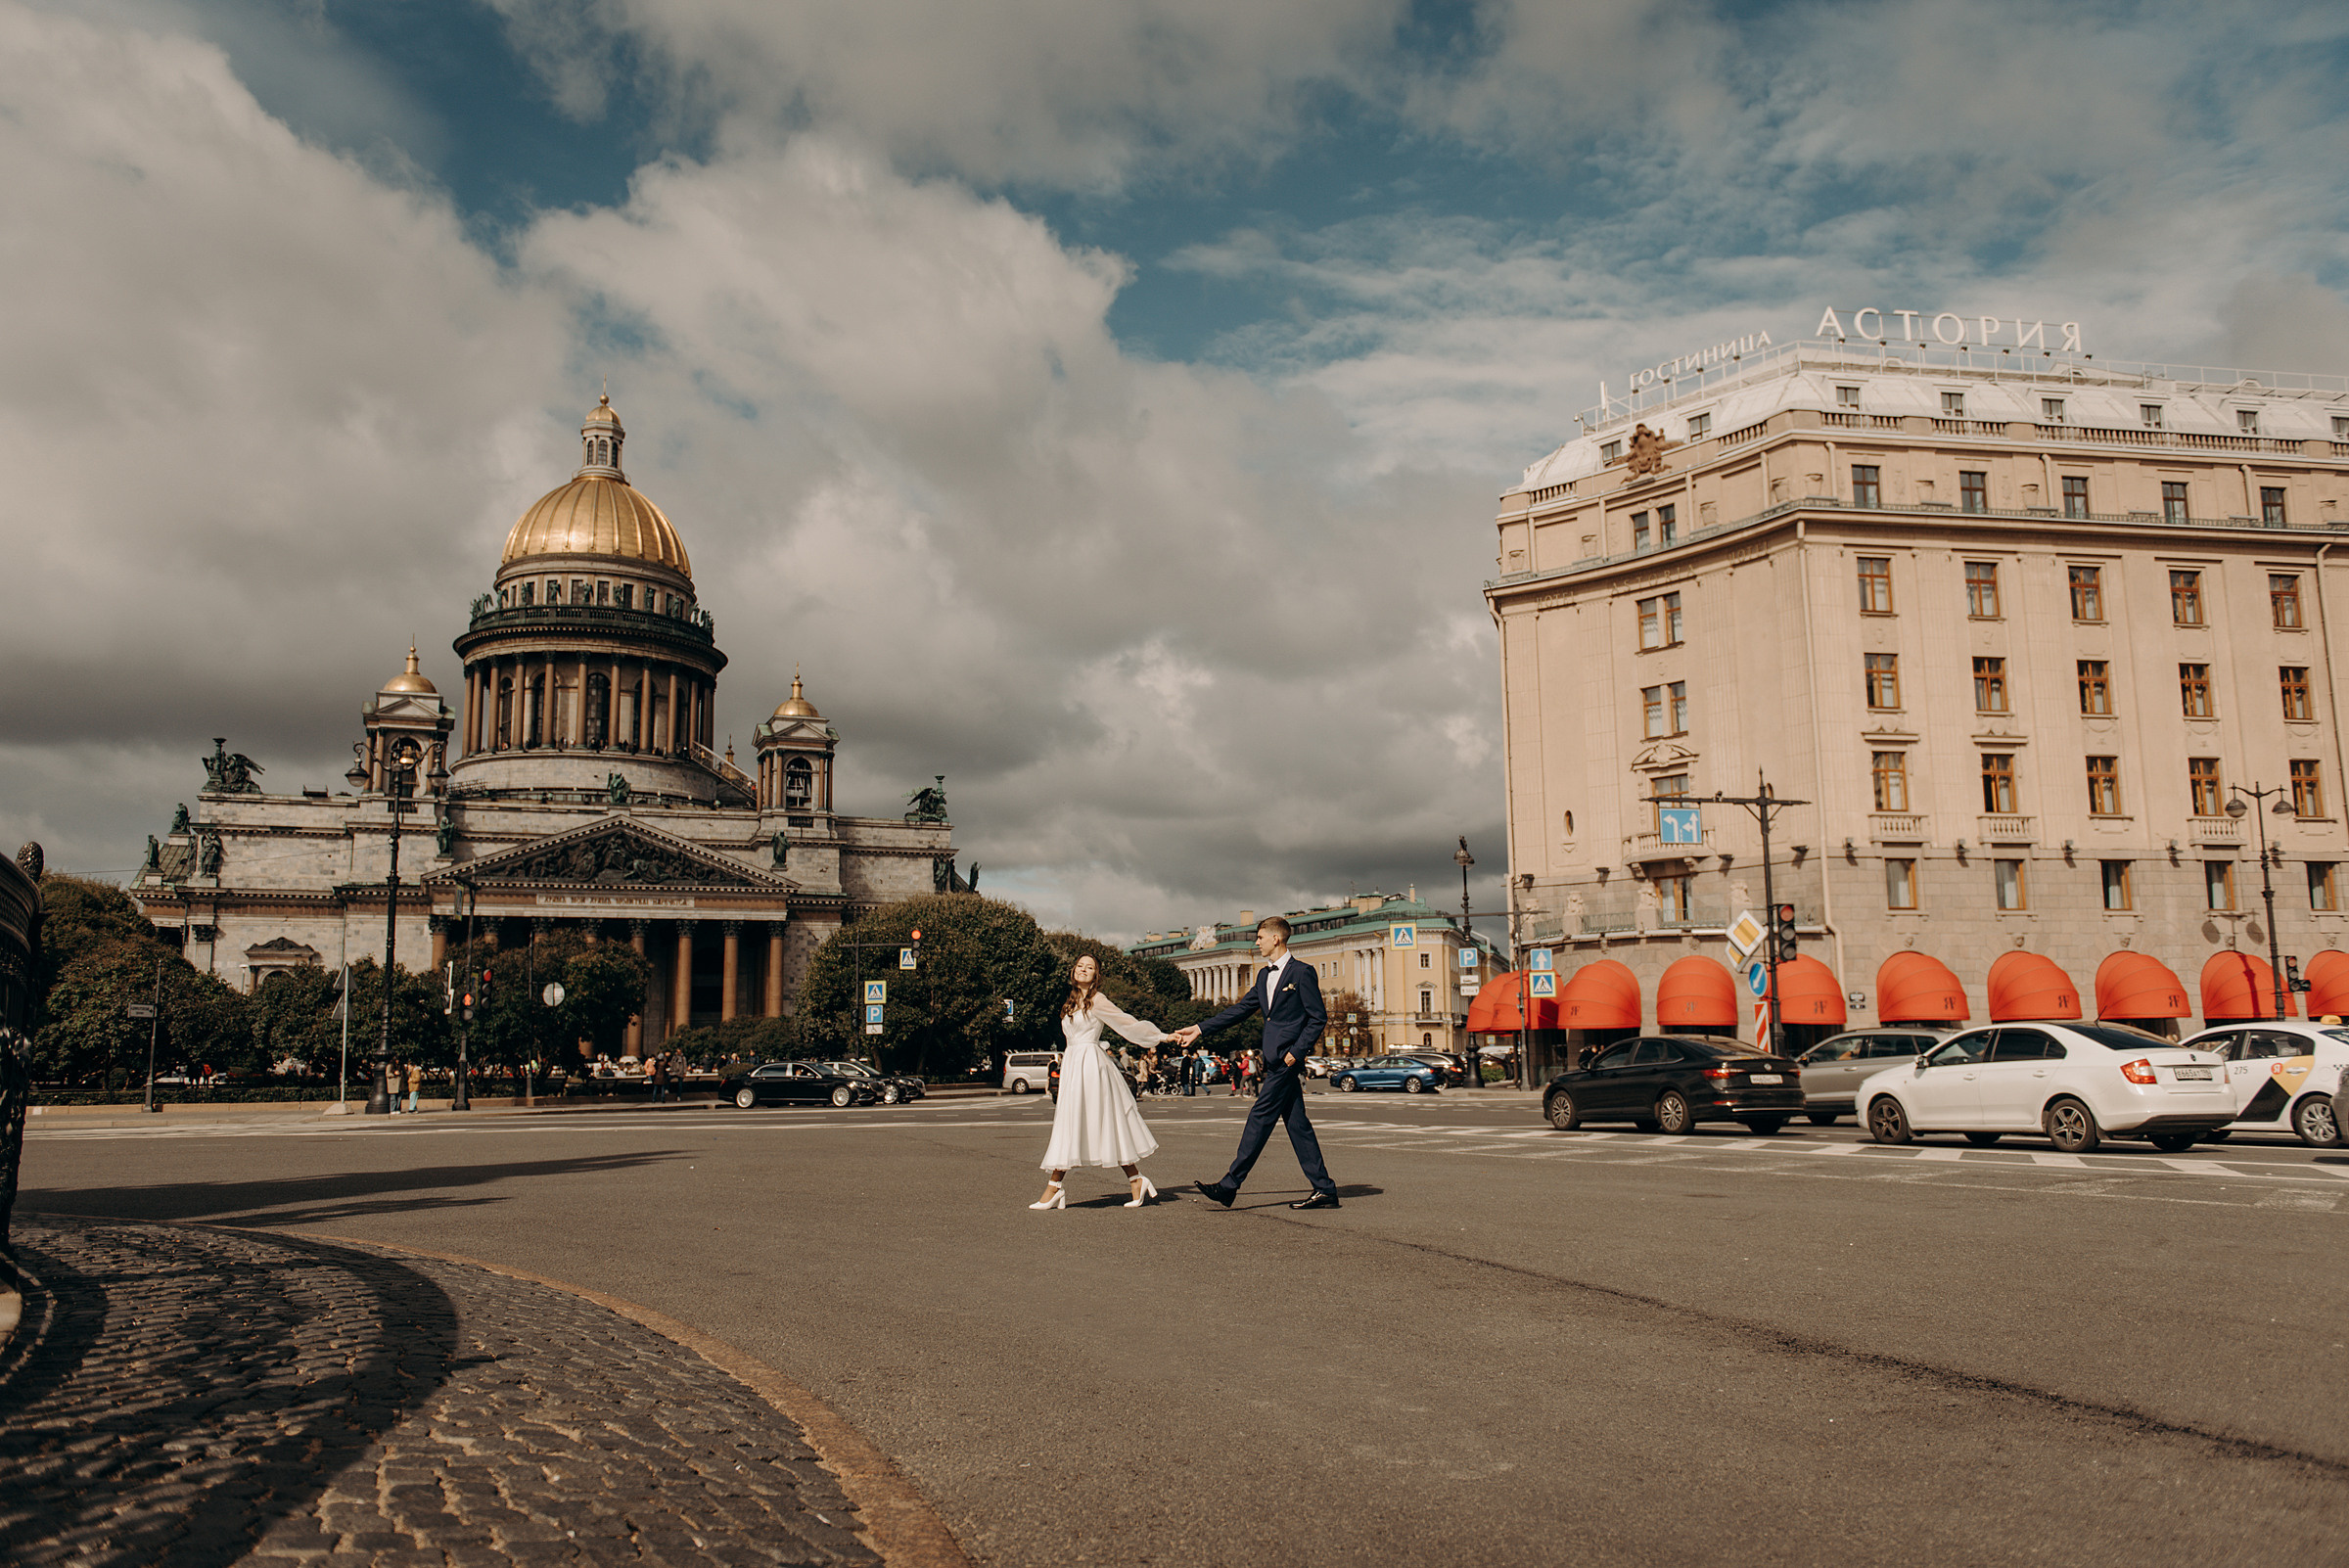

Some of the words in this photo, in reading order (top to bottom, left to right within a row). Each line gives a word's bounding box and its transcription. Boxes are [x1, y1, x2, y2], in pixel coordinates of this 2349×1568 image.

[1630, 330, 1772, 391] ГОСТИНИЦА
[1816, 305, 2082, 352] АСТОРИЯ
[1536, 591, 1576, 609] HOTEL
[1611, 564, 1697, 595] ASTORIA
[1463, 950, 1474, 965] P
[870, 1008, 880, 1021] P
[2234, 1066, 2248, 1075] 275
